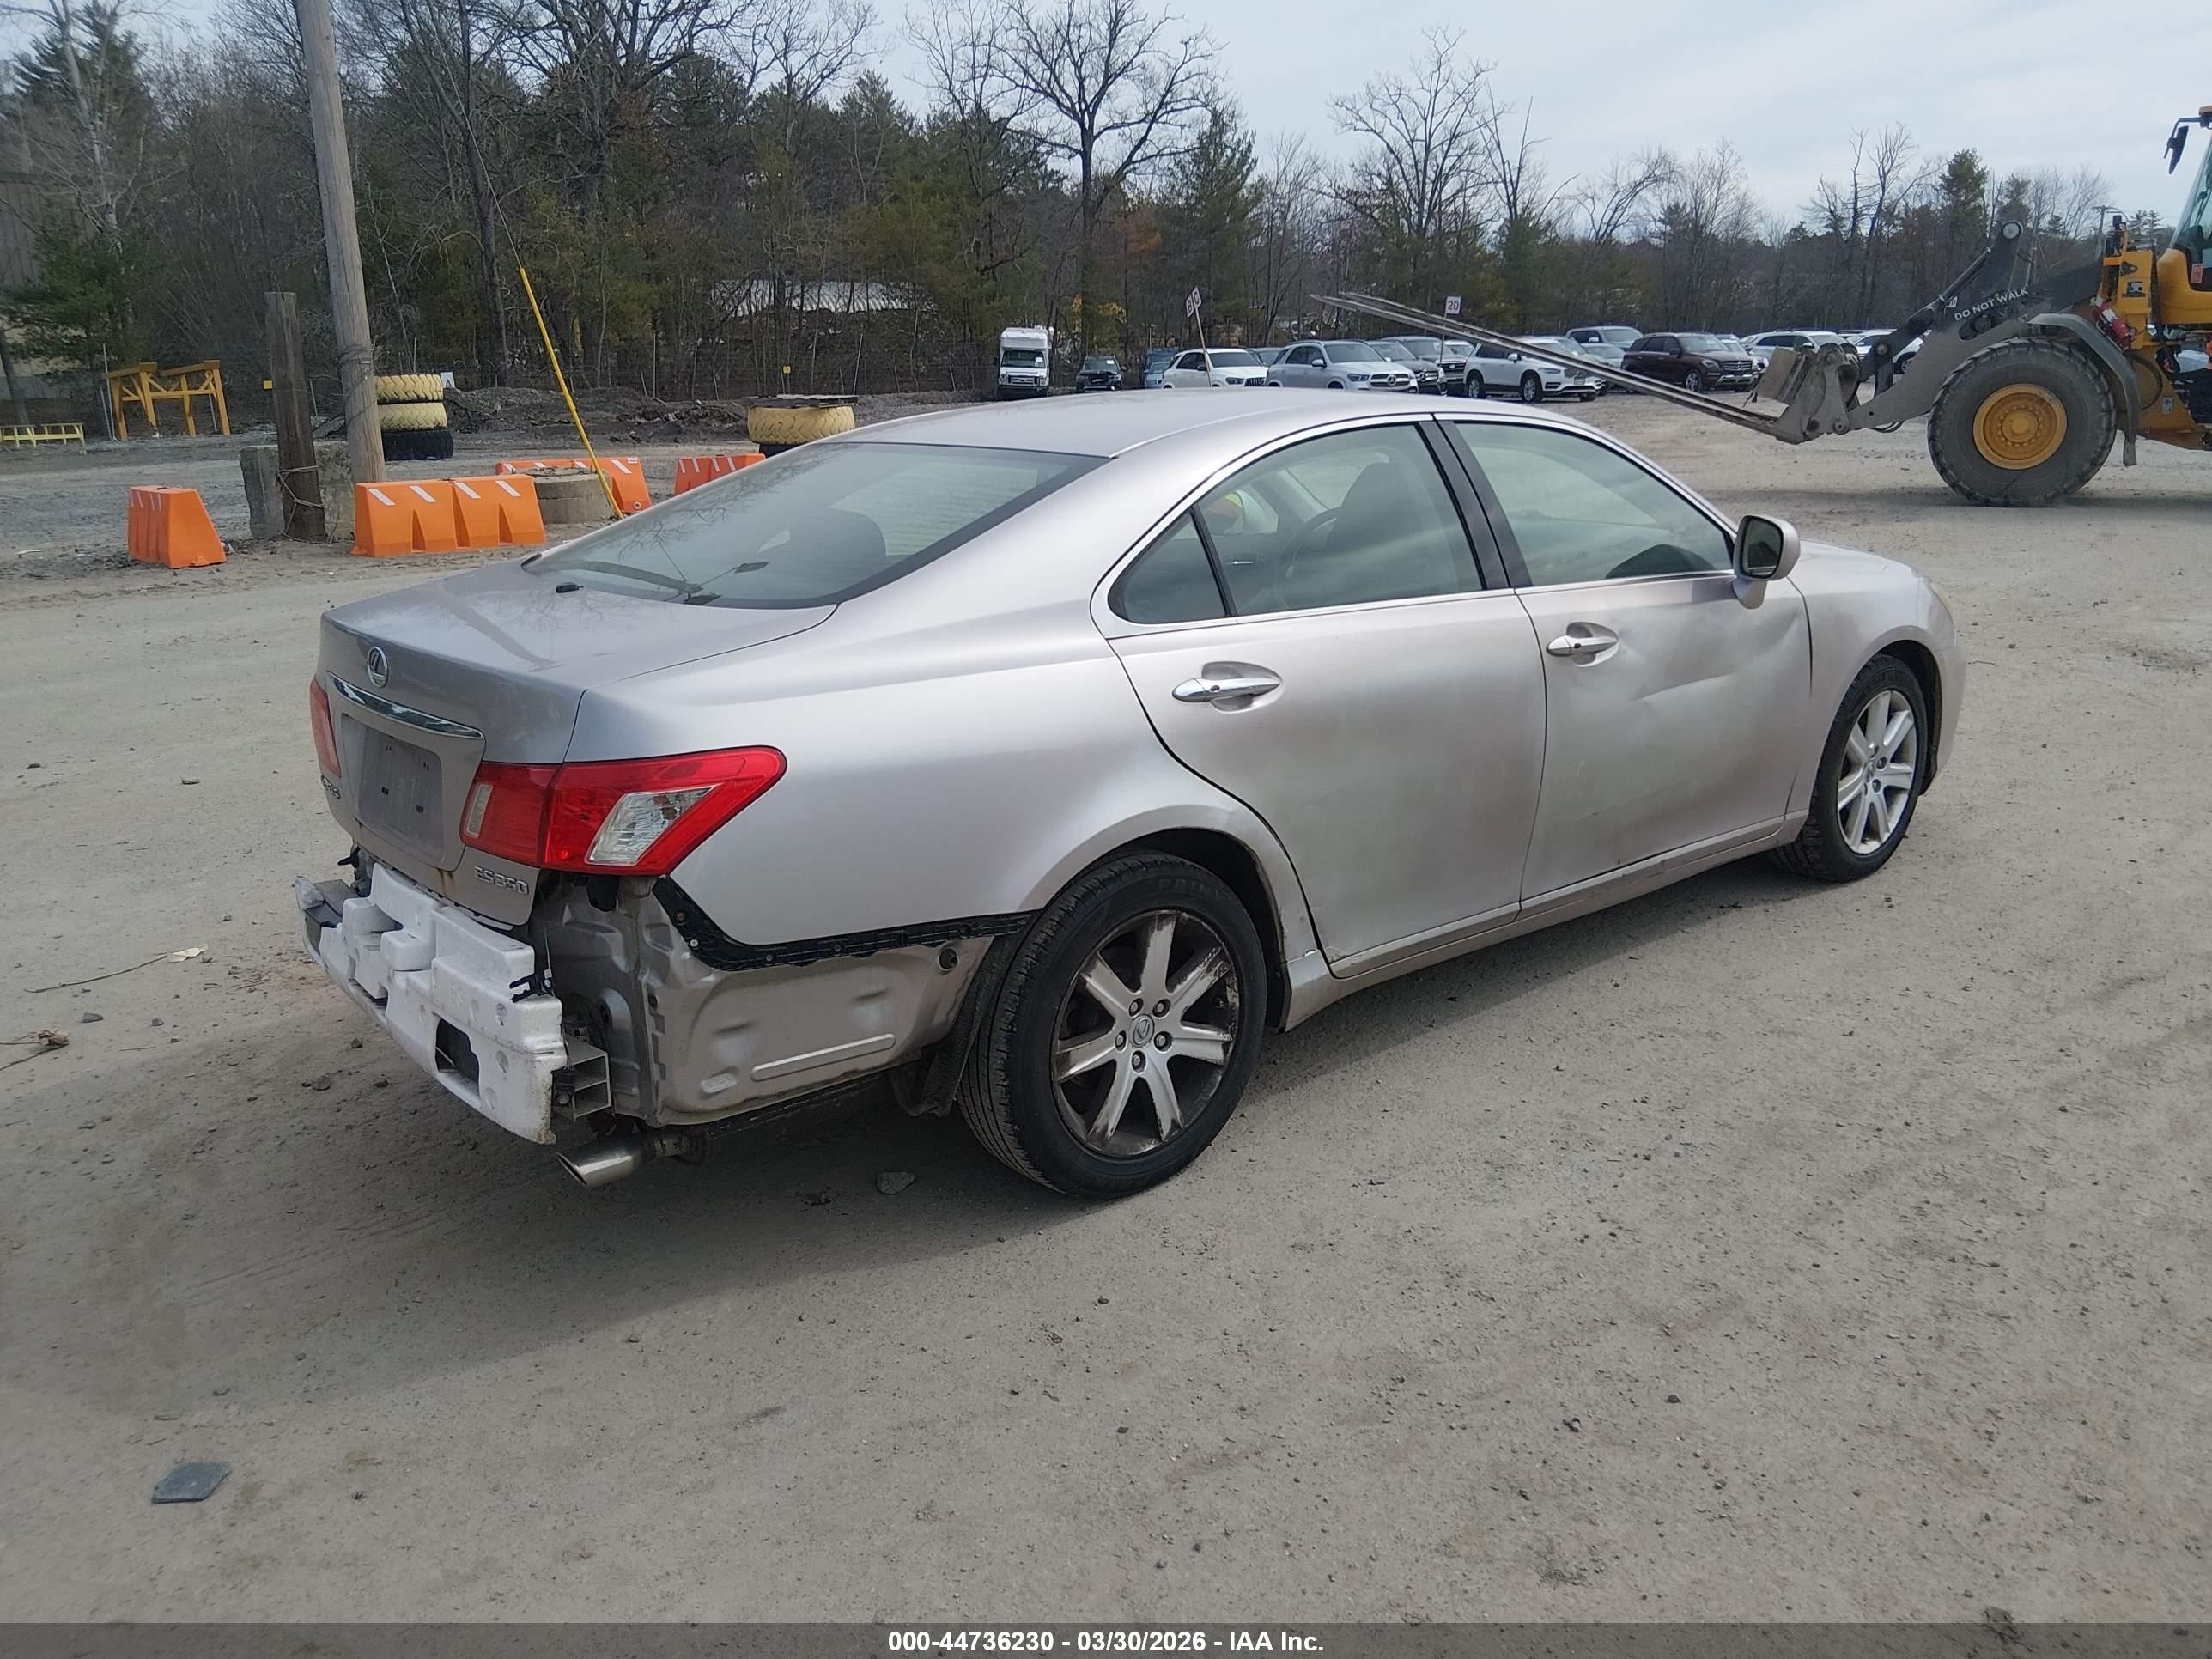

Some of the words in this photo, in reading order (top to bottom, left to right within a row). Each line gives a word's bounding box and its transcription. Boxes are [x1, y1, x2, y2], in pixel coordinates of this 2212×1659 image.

[1448, 300, 1459, 311] 20
[1954, 309, 1971, 321] DO
[1972, 298, 1995, 314] NOT
[1996, 287, 2029, 303] WALK
